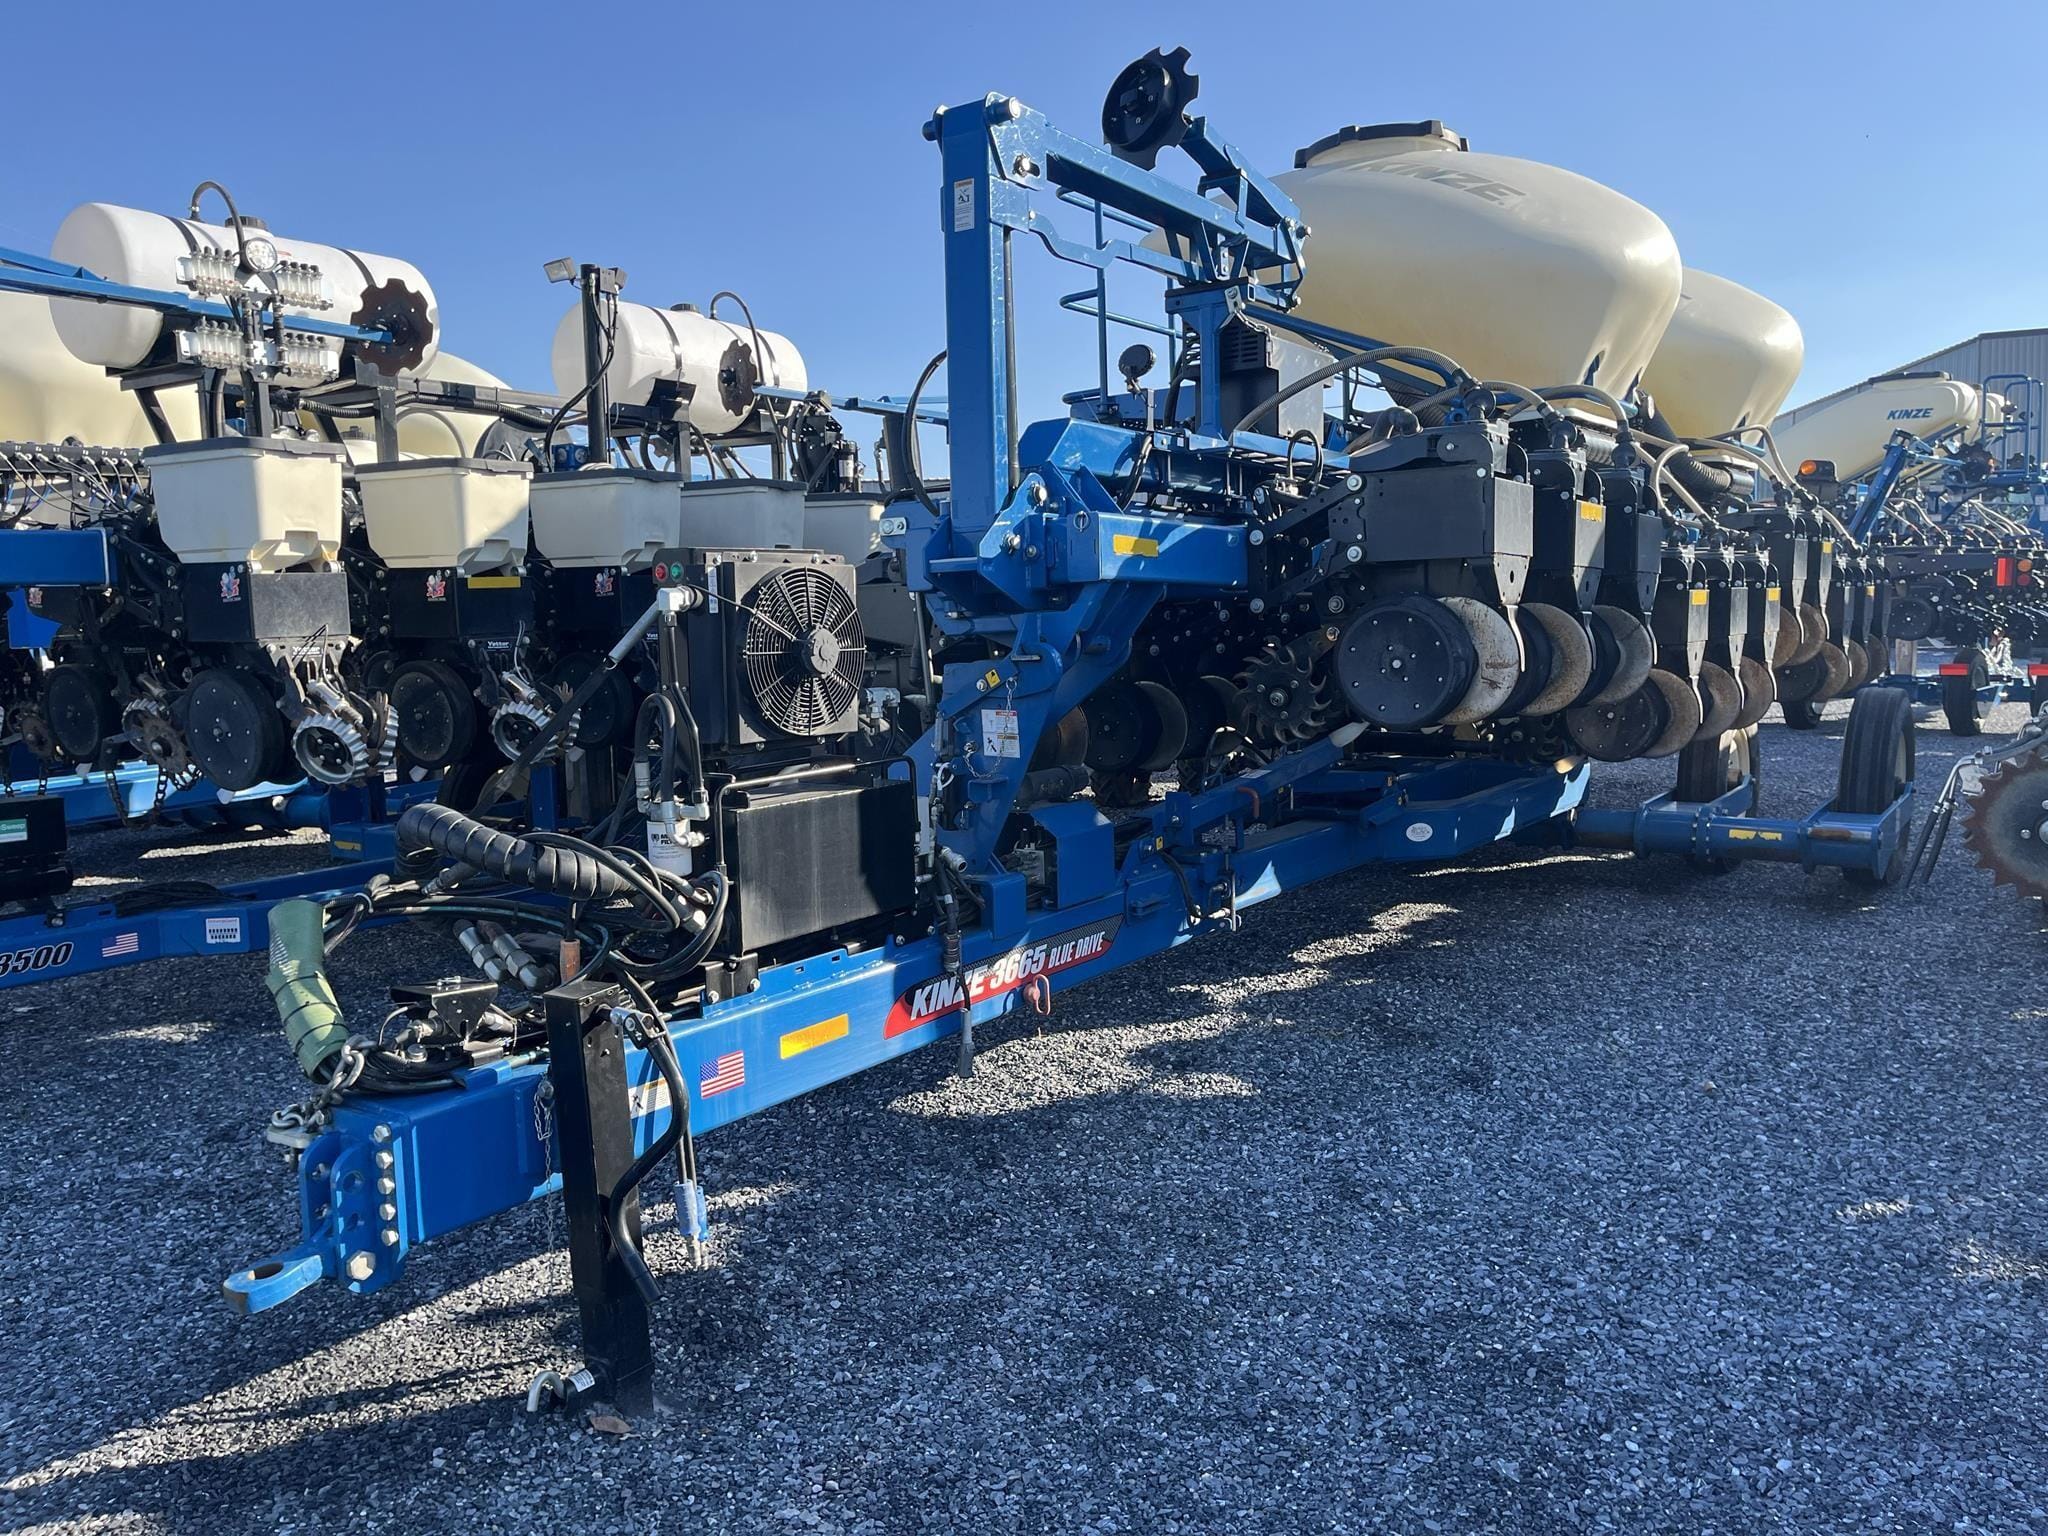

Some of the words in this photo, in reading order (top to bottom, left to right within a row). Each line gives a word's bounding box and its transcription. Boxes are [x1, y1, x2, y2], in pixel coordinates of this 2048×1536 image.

[1349, 162, 1527, 203] KINZE
[1887, 408, 1934, 420] KINZE
[989, 944, 1048, 990] 3665
[1048, 941, 1076, 969] BLUE
[1075, 931, 1106, 960] DRIVE
